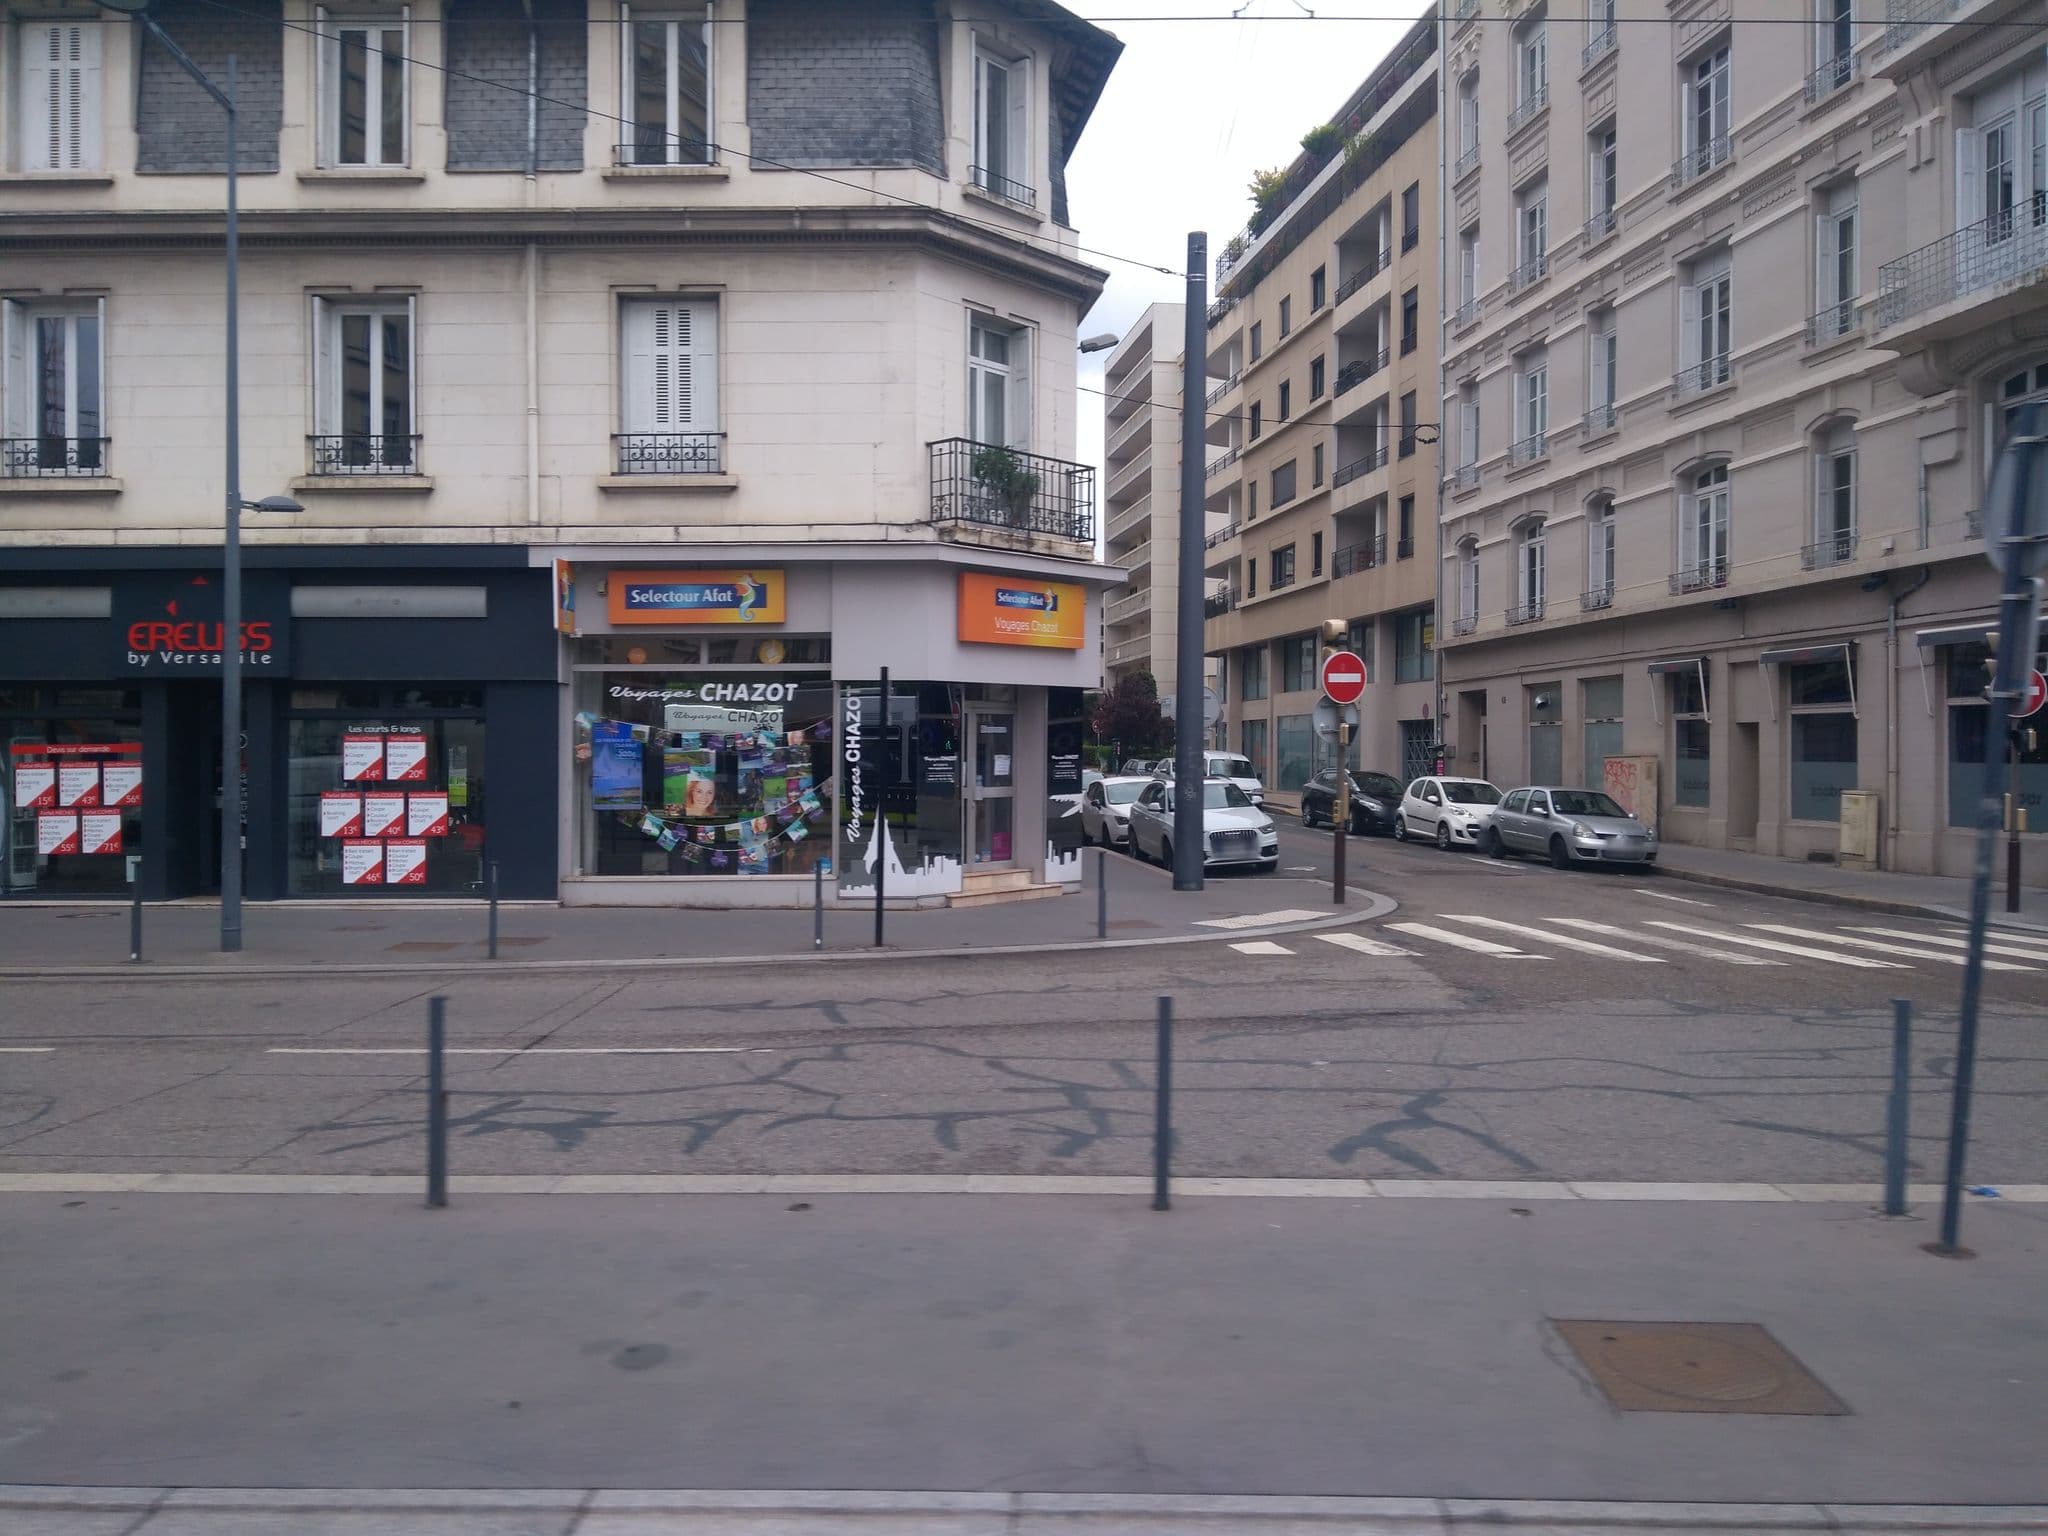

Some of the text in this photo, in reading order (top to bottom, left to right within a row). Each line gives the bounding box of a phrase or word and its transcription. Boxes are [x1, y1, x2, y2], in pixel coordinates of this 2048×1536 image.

[631, 588, 733, 603] Selectour Afat
[994, 617, 1059, 634] Voyages Chazot
[127, 651, 272, 667] by Versaile
[608, 683, 799, 702] Voyages CHAZOT
[844, 686, 865, 843] Voyages CHAZOT
